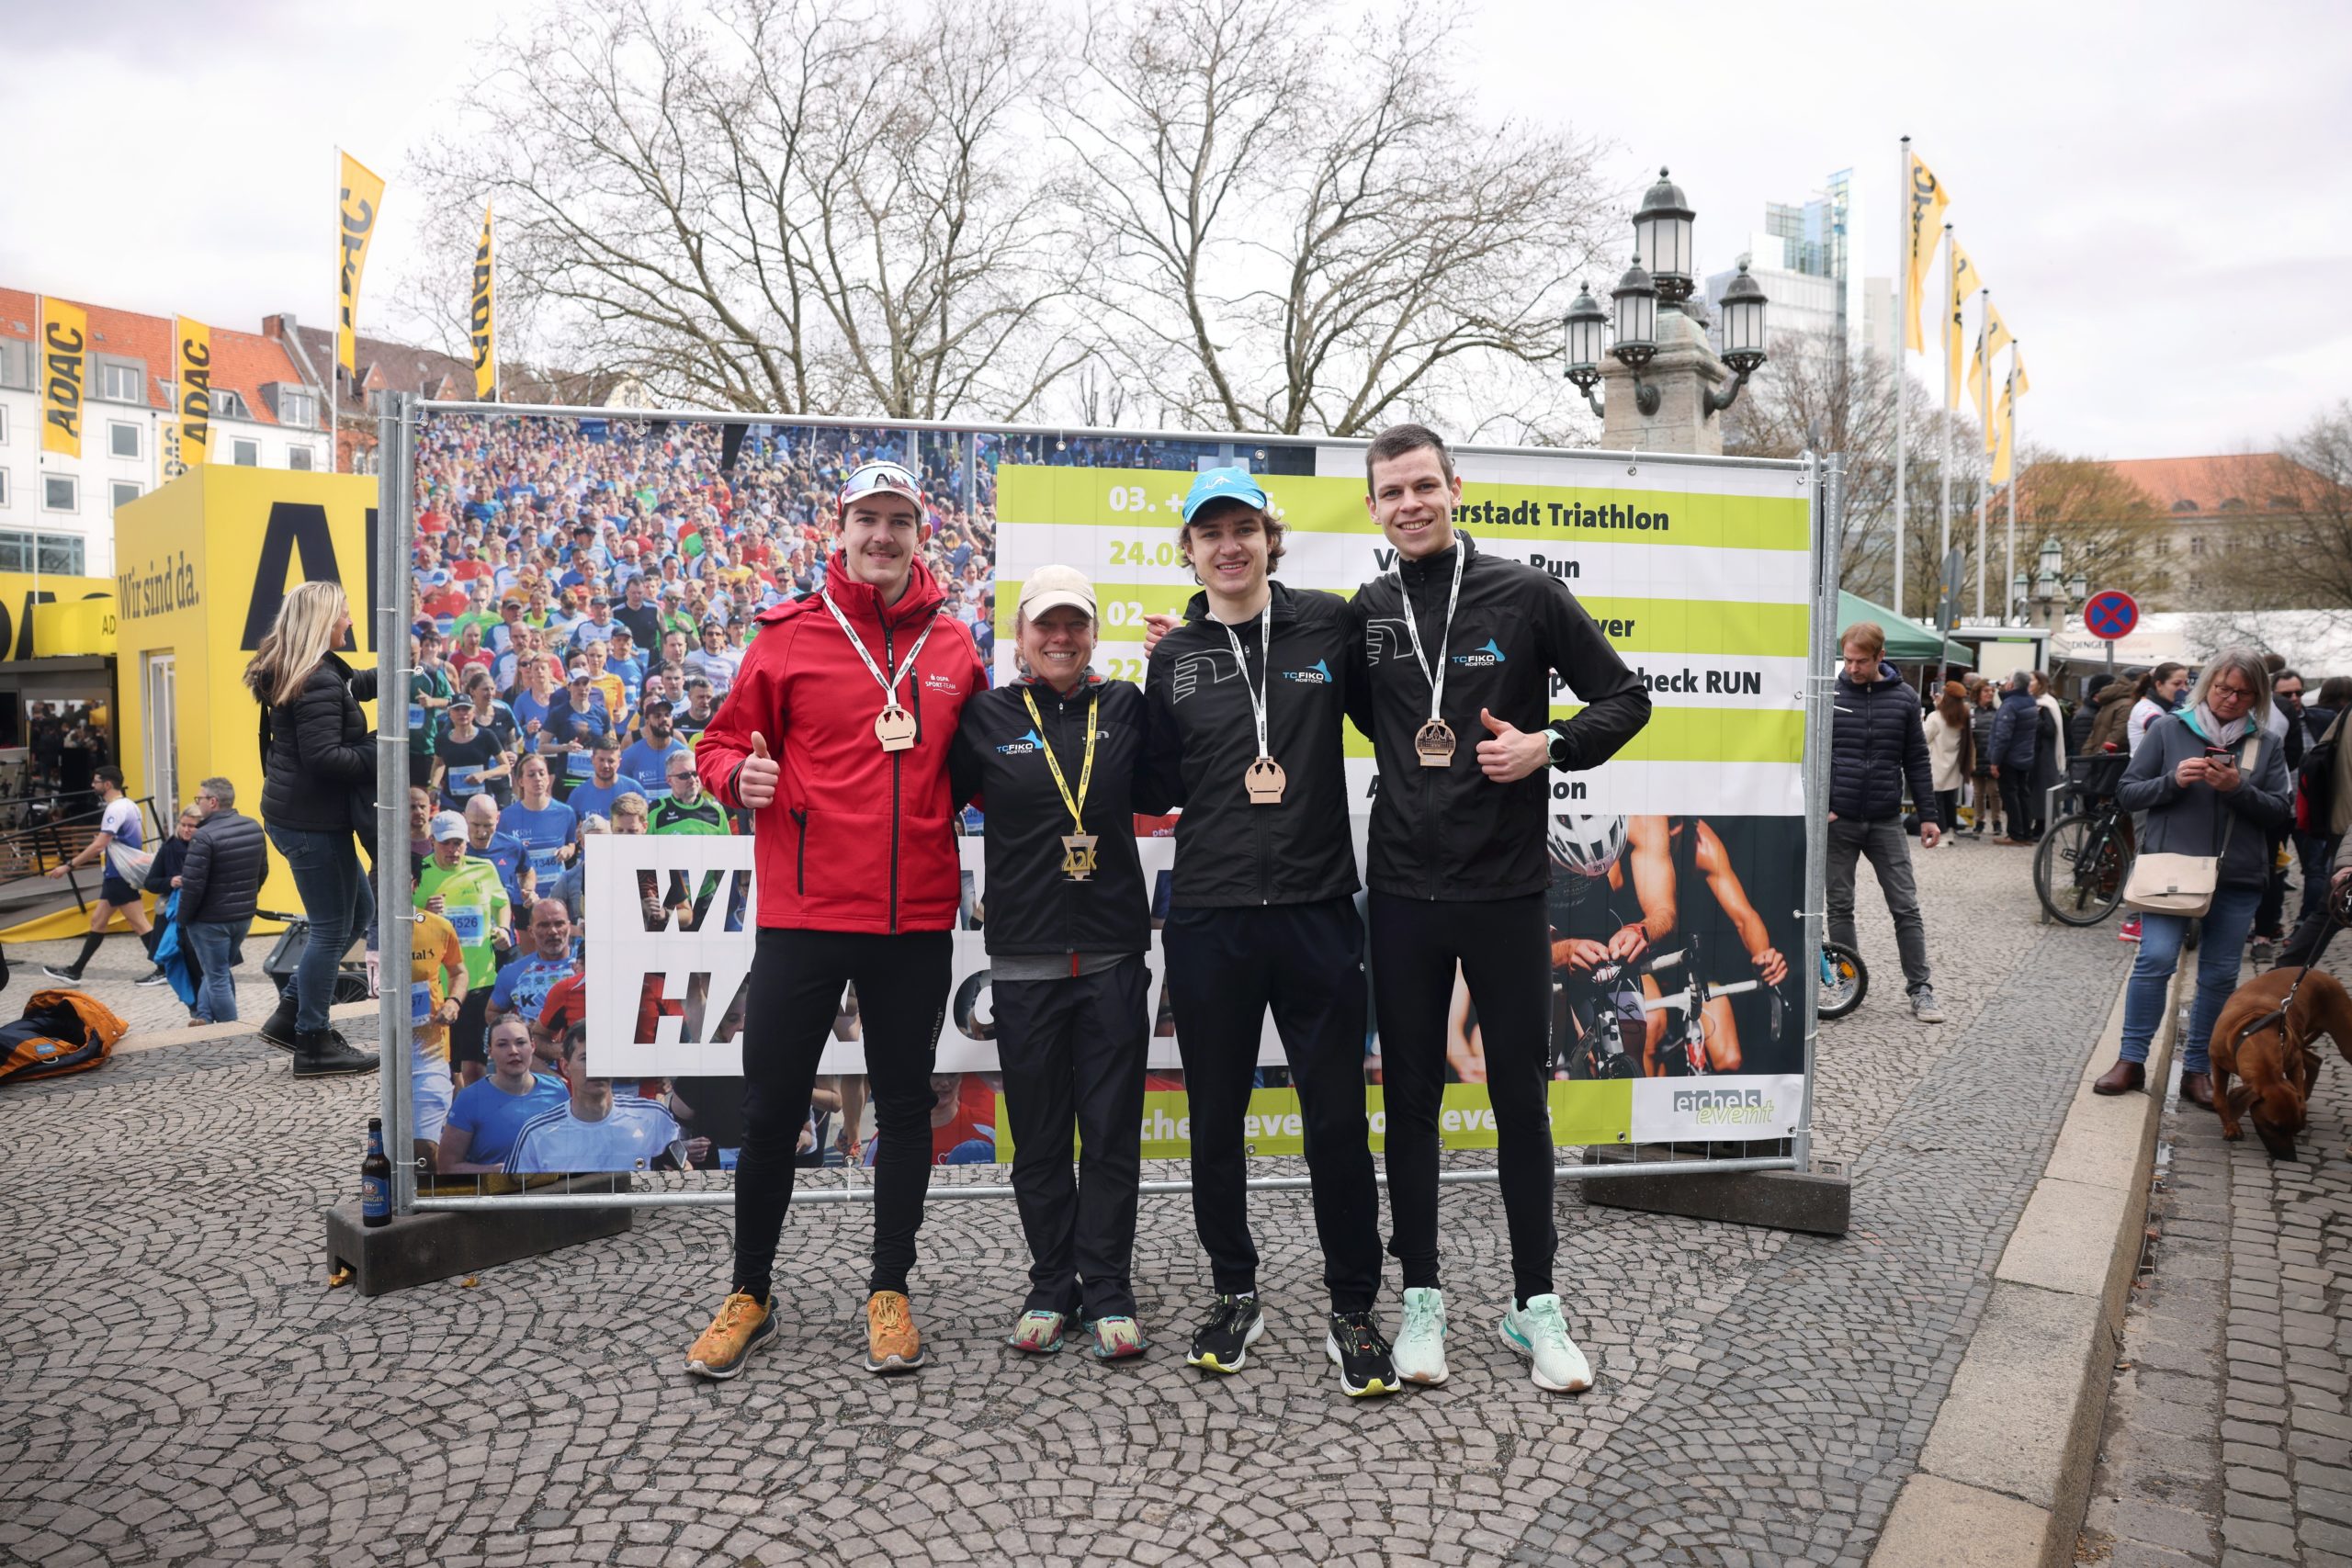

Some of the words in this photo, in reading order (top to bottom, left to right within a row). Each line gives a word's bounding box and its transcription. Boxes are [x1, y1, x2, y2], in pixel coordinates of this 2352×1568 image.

[46, 322, 84, 439] ADAC
[183, 339, 210, 446] ADAC
[1109, 485, 1157, 513] 03.
[1547, 502, 1669, 531] Triathlon
[1530, 554, 1580, 579] Run
[119, 565, 141, 620] Wir
[143, 555, 174, 617] sind
[175, 549, 199, 610] da.
[1706, 670, 1761, 695] RUN
[1062, 850, 1098, 876] 42K
[1676, 1089, 1759, 1112] eichels
[1696, 1099, 1775, 1125] event
